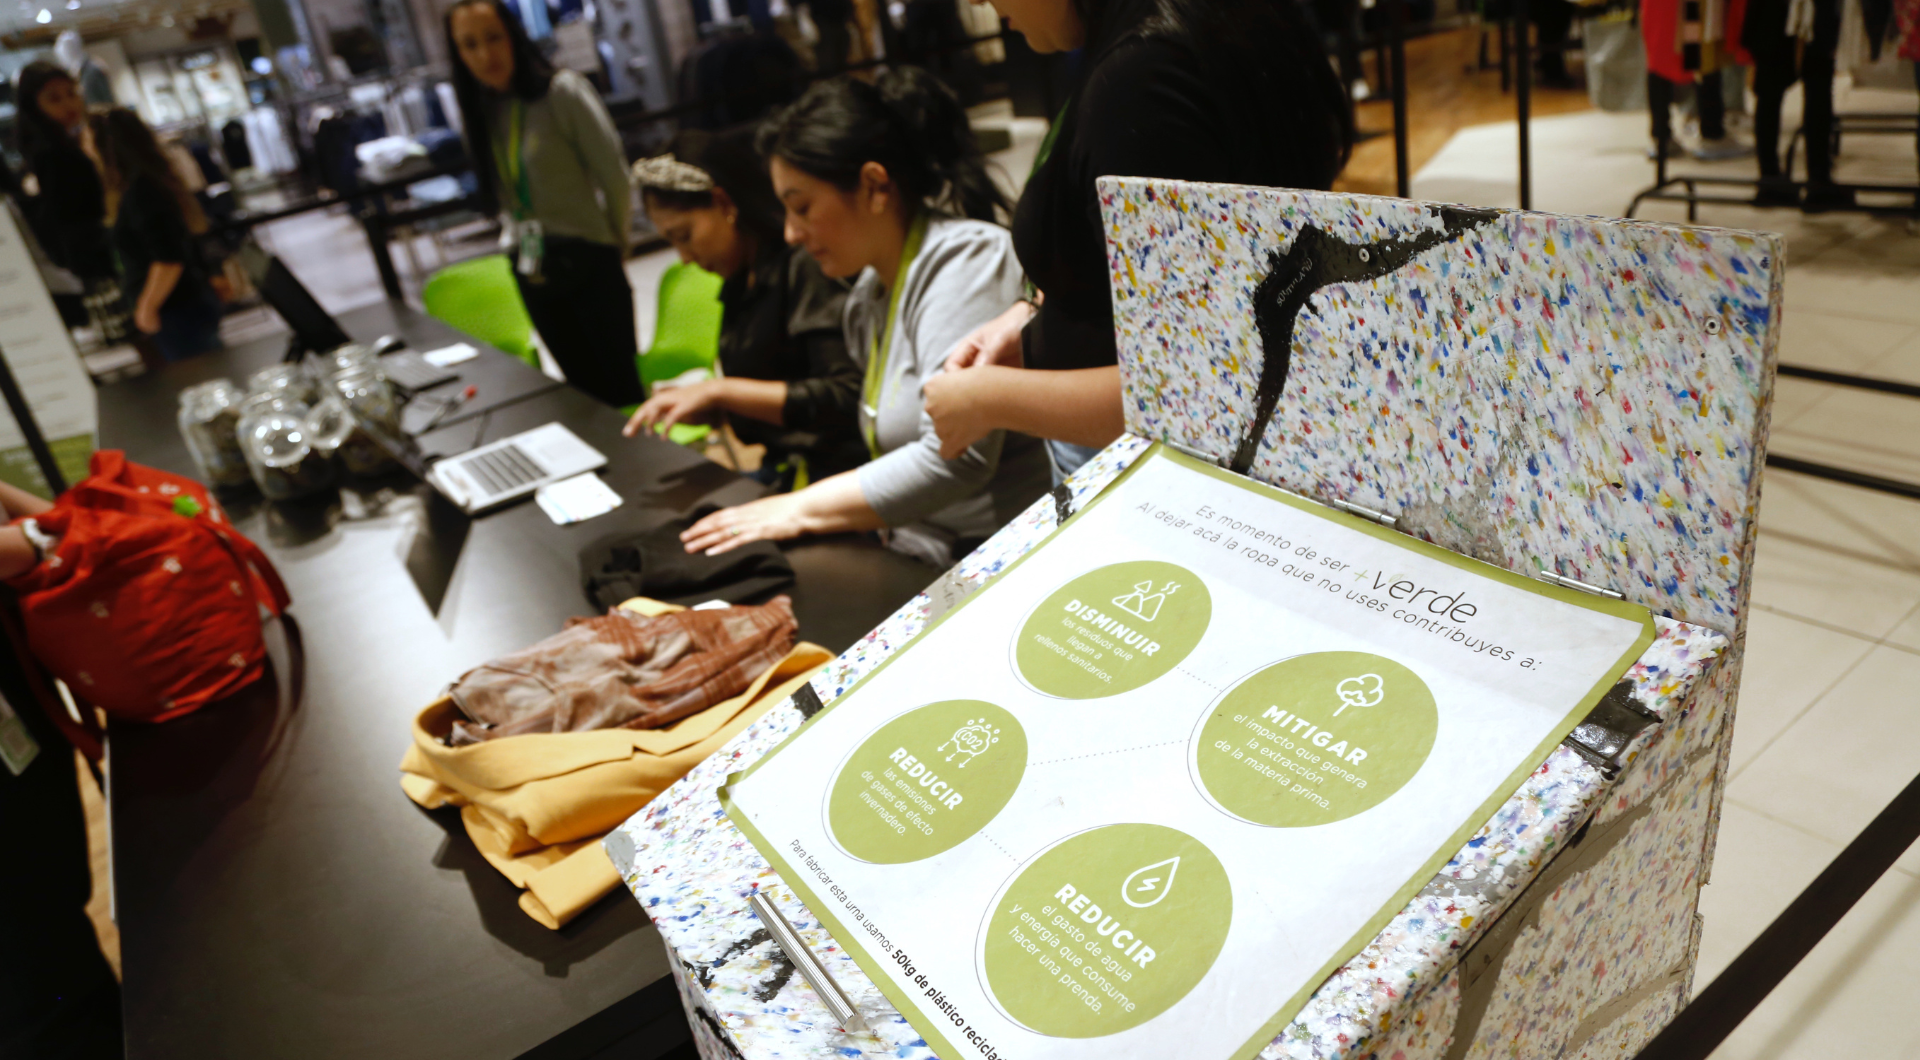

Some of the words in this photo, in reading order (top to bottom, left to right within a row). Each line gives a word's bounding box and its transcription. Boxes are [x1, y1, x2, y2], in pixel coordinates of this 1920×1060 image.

[1195, 505, 1216, 520] Es
[1217, 515, 1291, 550] momento
[1295, 546, 1317, 560] de
[1320, 556, 1350, 572] ser
[1136, 501, 1155, 514] Al
[1155, 509, 1193, 530] dejar
[1193, 525, 1223, 543] acá
[1223, 537, 1239, 551] la
[1240, 546, 1279, 568] ropa
[1282, 563, 1315, 582] que
[1317, 577, 1342, 593] no
[1346, 589, 1389, 612] uses
[1393, 608, 1515, 661] contribuyes
[1520, 657, 1542, 671] a:
[1034, 634, 1068, 657] rellenos
[1067, 652, 1113, 684] sanitarios.
[1061, 617, 1075, 629] los
[1075, 624, 1114, 650] residuos
[1114, 646, 1134, 661] que
[1064, 599, 1161, 656] DISMINUIR
[1066, 635, 1095, 655] llegan
[1094, 652, 1103, 660] a
[1233, 714, 1248, 724] el
[1245, 719, 1295, 750] impacto
[1295, 747, 1321, 764] que
[1320, 761, 1368, 789] genera
[1246, 737, 1260, 750] la
[1260, 747, 1324, 785] extracción
[1261, 705, 1368, 766] MITIGAR
[861, 770, 874, 783] de
[870, 779, 896, 803] gases
[894, 799, 908, 813] de
[906, 810, 934, 836] efecto
[883, 768, 897, 781] las
[895, 779, 937, 815] emisiones
[889, 747, 963, 811] REDUCIR
[1214, 739, 1231, 753] de
[1231, 747, 1244, 760] la
[1244, 755, 1291, 787] materia
[1289, 783, 1330, 810] prima.
[859, 789, 906, 836] invernadero.
[789, 838, 807, 859] Para
[803, 855, 833, 886] fabricar
[829, 884, 848, 903] esta
[845, 900, 865, 922] urna
[862, 918, 894, 953] usamos
[892, 949, 917, 977] 50kg
[914, 974, 929, 989] de
[924, 987, 965, 1027] plástico
[962, 1026, 1006, 1060] recicla
[1009, 903, 1022, 915] y
[1020, 912, 1061, 948] energía
[1059, 946, 1083, 968] que
[1082, 965, 1136, 1013] consume
[1042, 905, 1057, 917] el
[1051, 914, 1085, 943] gasto
[1085, 941, 1102, 957] de
[1101, 955, 1133, 982] agua
[1054, 883, 1156, 969] REDUCIR
[1008, 925, 1041, 956] hacer
[1038, 954, 1062, 976] una
[1058, 974, 1103, 1015] prenda.
